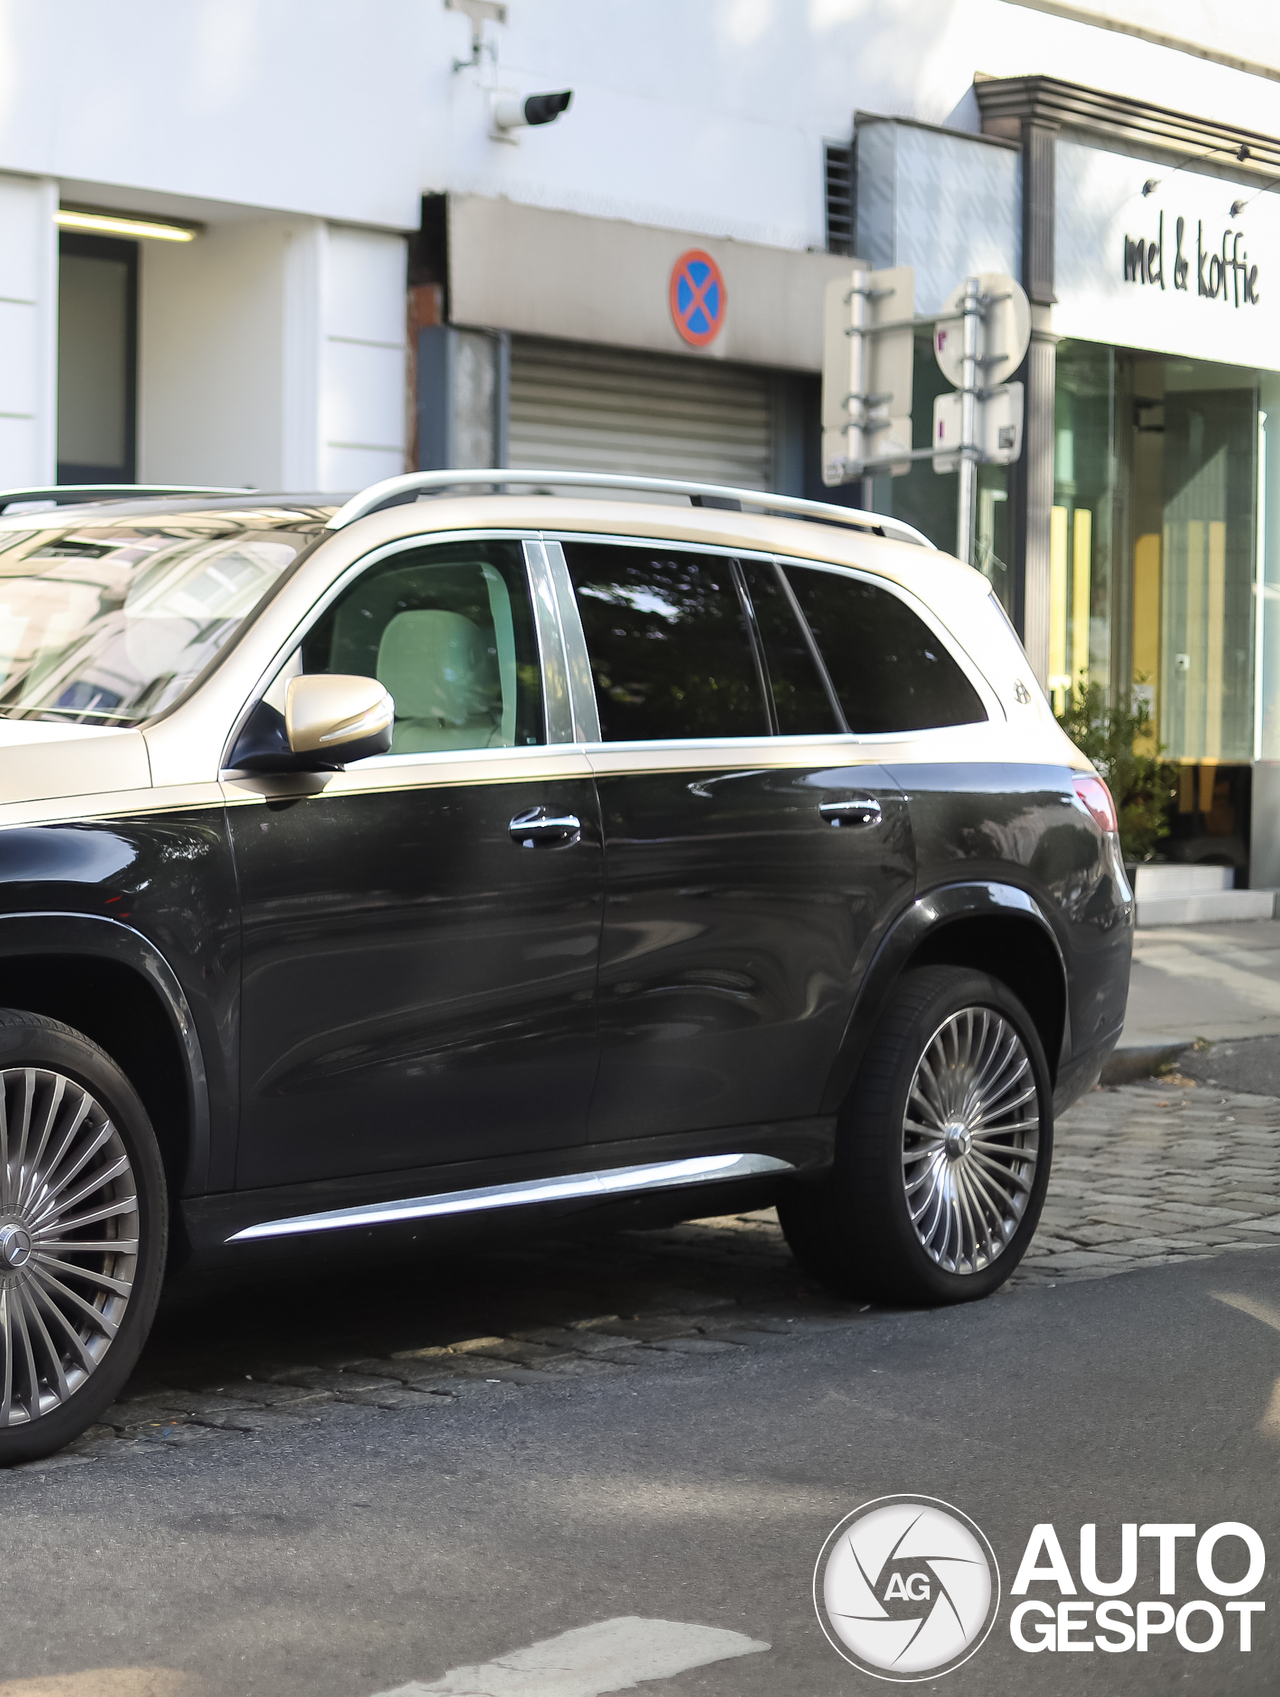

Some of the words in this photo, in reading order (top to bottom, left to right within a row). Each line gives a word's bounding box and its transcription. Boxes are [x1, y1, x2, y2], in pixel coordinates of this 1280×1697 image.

[1124, 209, 1166, 291] mel
[1174, 216, 1189, 292] &
[1196, 219, 1260, 309] koffie
